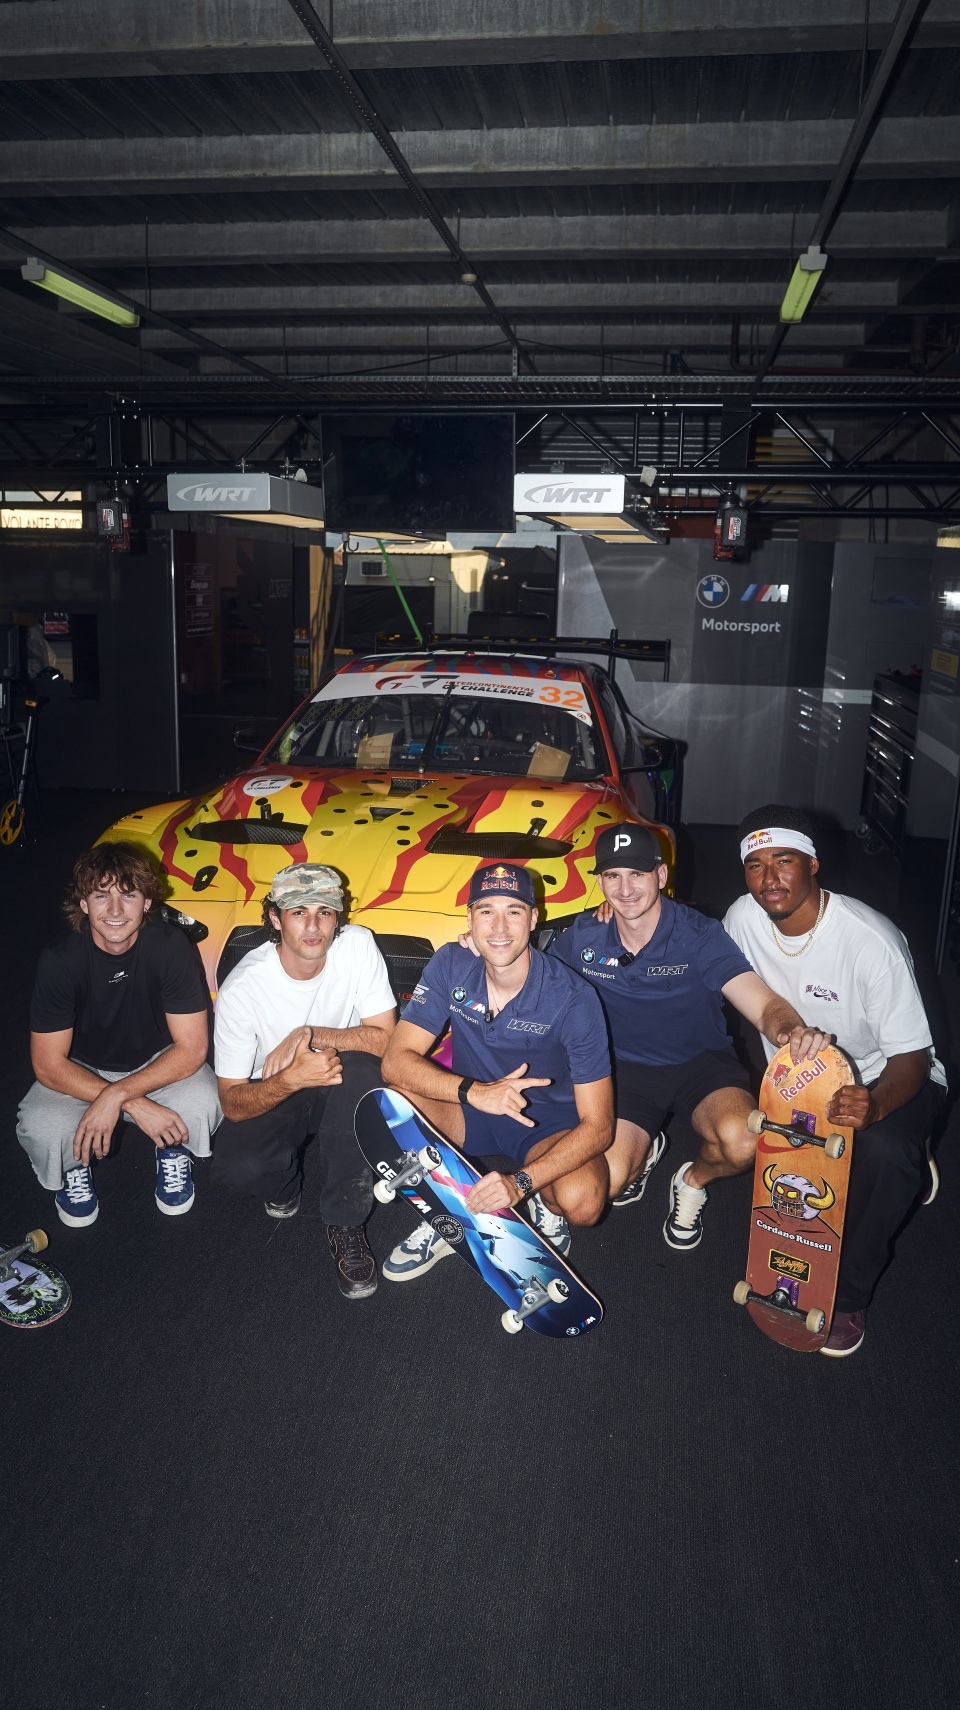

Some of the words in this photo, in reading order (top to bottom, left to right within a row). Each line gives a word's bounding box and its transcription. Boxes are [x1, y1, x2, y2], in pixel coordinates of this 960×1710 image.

[193, 487, 257, 502] WRT
[542, 487, 612, 504] WRT
[702, 618, 781, 634] Motorsport
[460, 685, 535, 698] CHALLENGE
[538, 685, 585, 709] 32
[746, 839, 758, 850] Red
[759, 836, 773, 845] Bull
[480, 878, 499, 891] Red
[500, 878, 519, 892] Bull
[582, 966, 616, 980] Motorsport
[646, 964, 688, 976] WRT
[449, 1004, 480, 1026] Motorsport
[506, 1018, 550, 1035] WRT
[779, 1075, 806, 1102] Red
[800, 1057, 828, 1084] Bull
[376, 1160, 398, 1181] GE
[757, 1219, 795, 1239] Cordano
[796, 1235, 832, 1251] Russell
